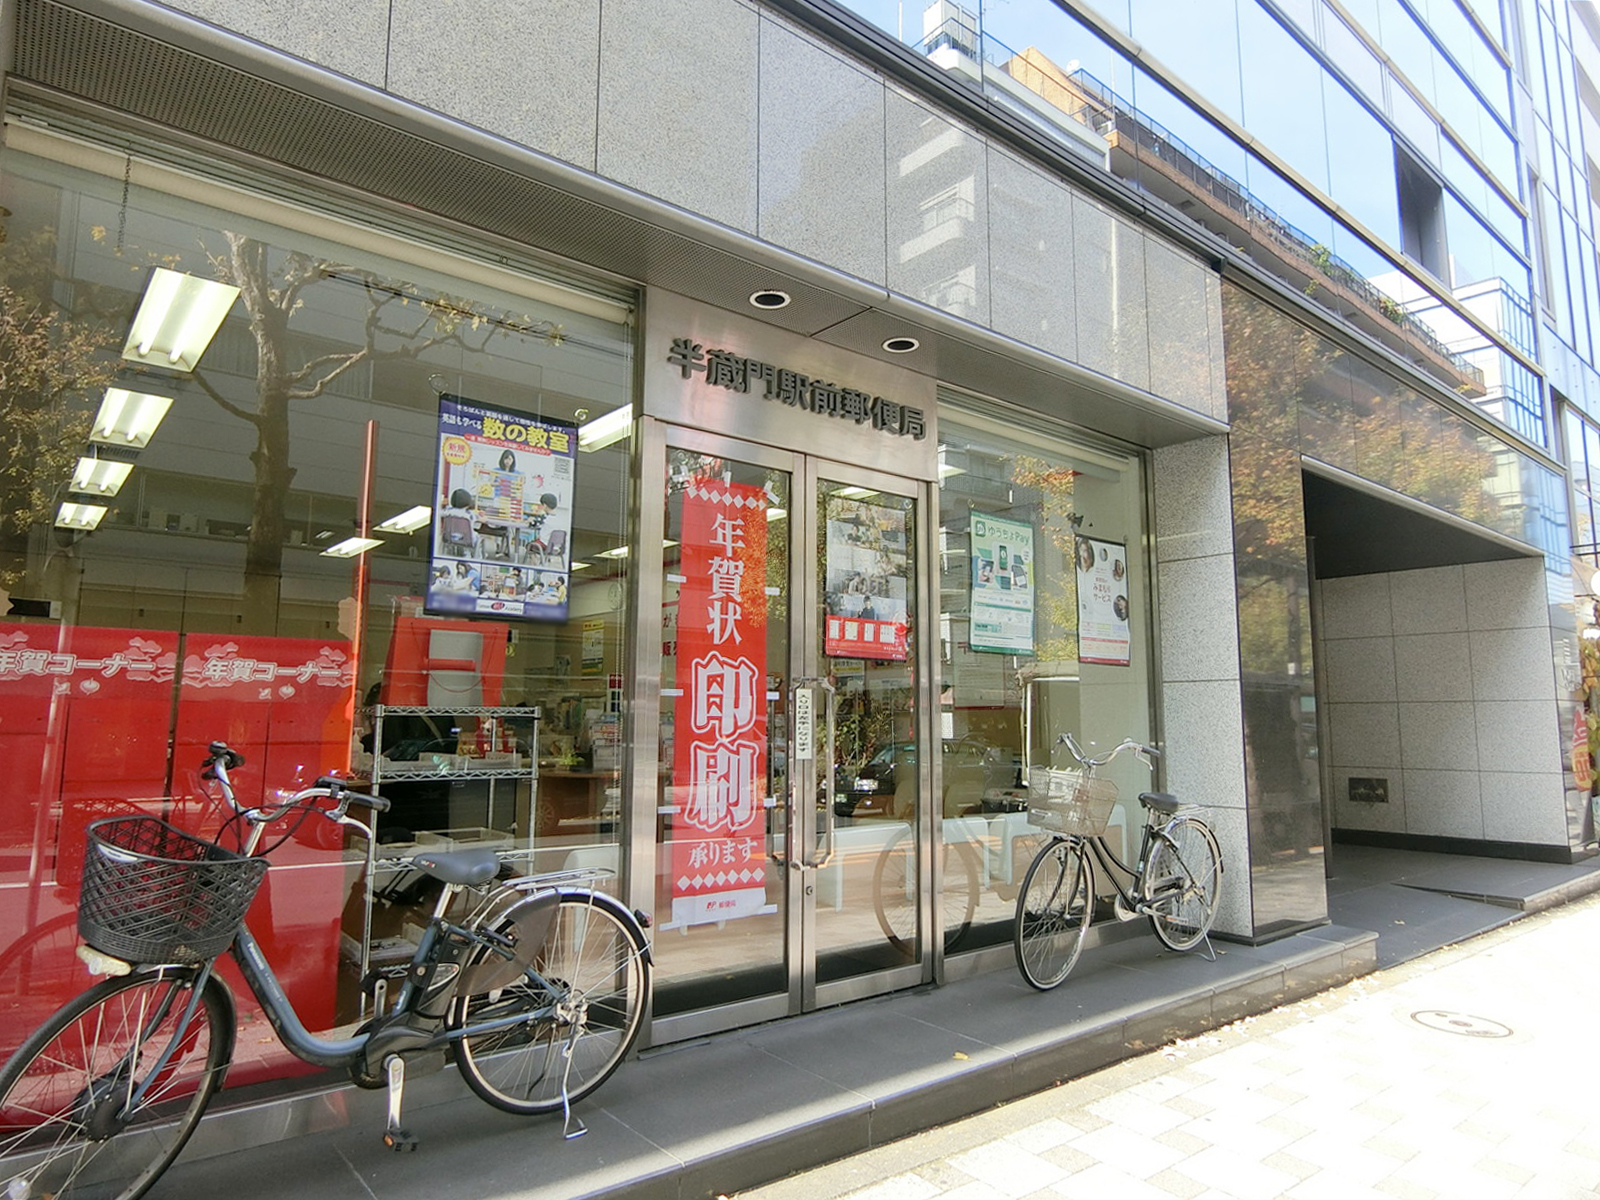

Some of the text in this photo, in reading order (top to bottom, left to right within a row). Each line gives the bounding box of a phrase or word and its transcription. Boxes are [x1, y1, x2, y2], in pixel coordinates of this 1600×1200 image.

[667, 338, 926, 440] 半蔵門駅前郵便局
[482, 417, 570, 453] 数の教室
[988, 526, 1030, 546] ゆうちょPay
[706, 513, 745, 645] 年賀状
[0, 649, 157, 677] 年賀コーナー
[202, 656, 342, 684] 年賀コーナー
[686, 651, 759, 832] 印刷
[688, 837, 758, 869] 承ります
